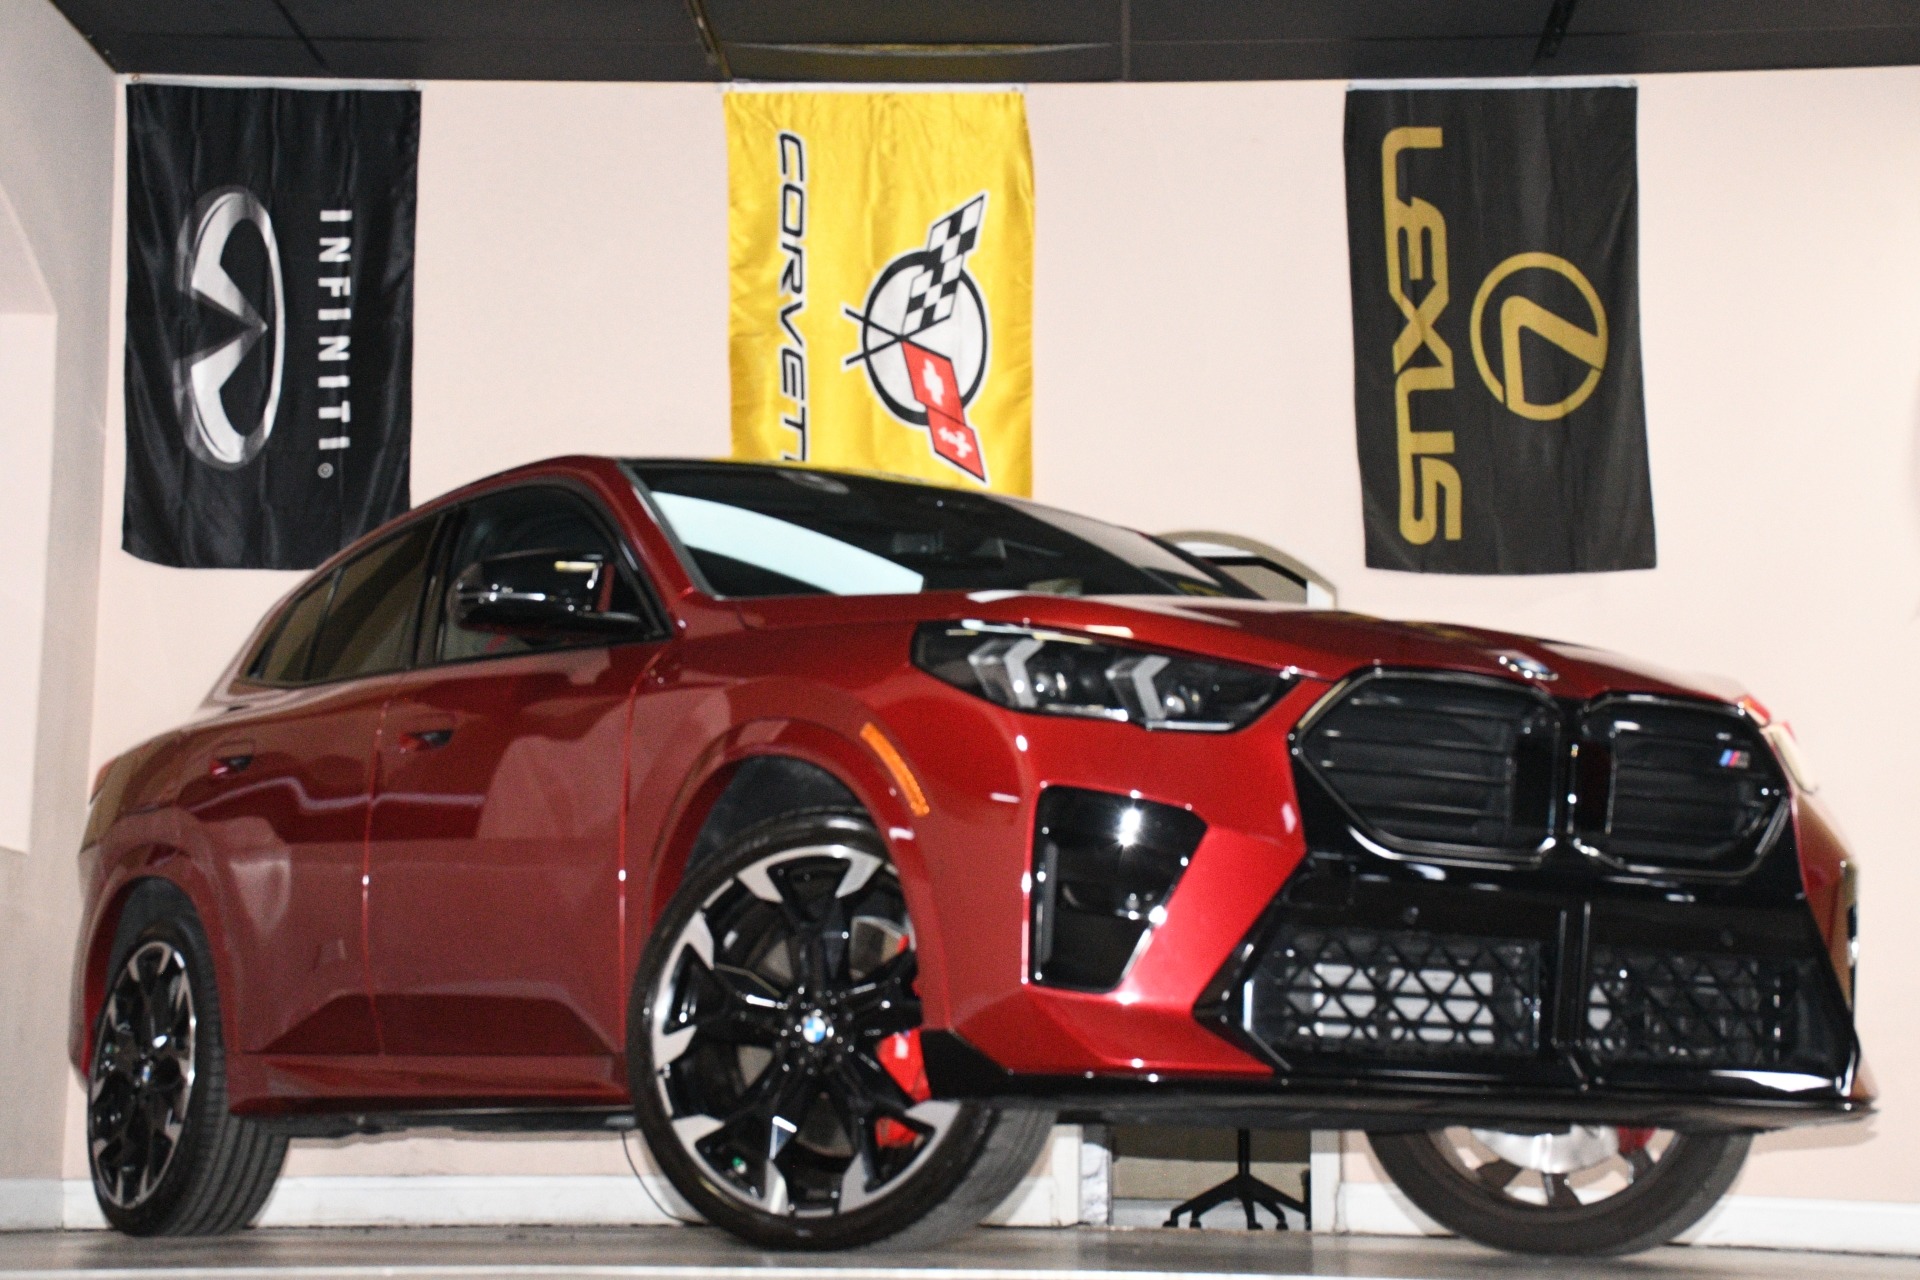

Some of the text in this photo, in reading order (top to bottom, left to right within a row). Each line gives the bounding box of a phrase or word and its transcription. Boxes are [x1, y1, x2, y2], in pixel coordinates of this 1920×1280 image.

[317, 209, 352, 450] INFINITI
[779, 133, 806, 461] CORVET
[1381, 126, 1462, 545] LEXUS
